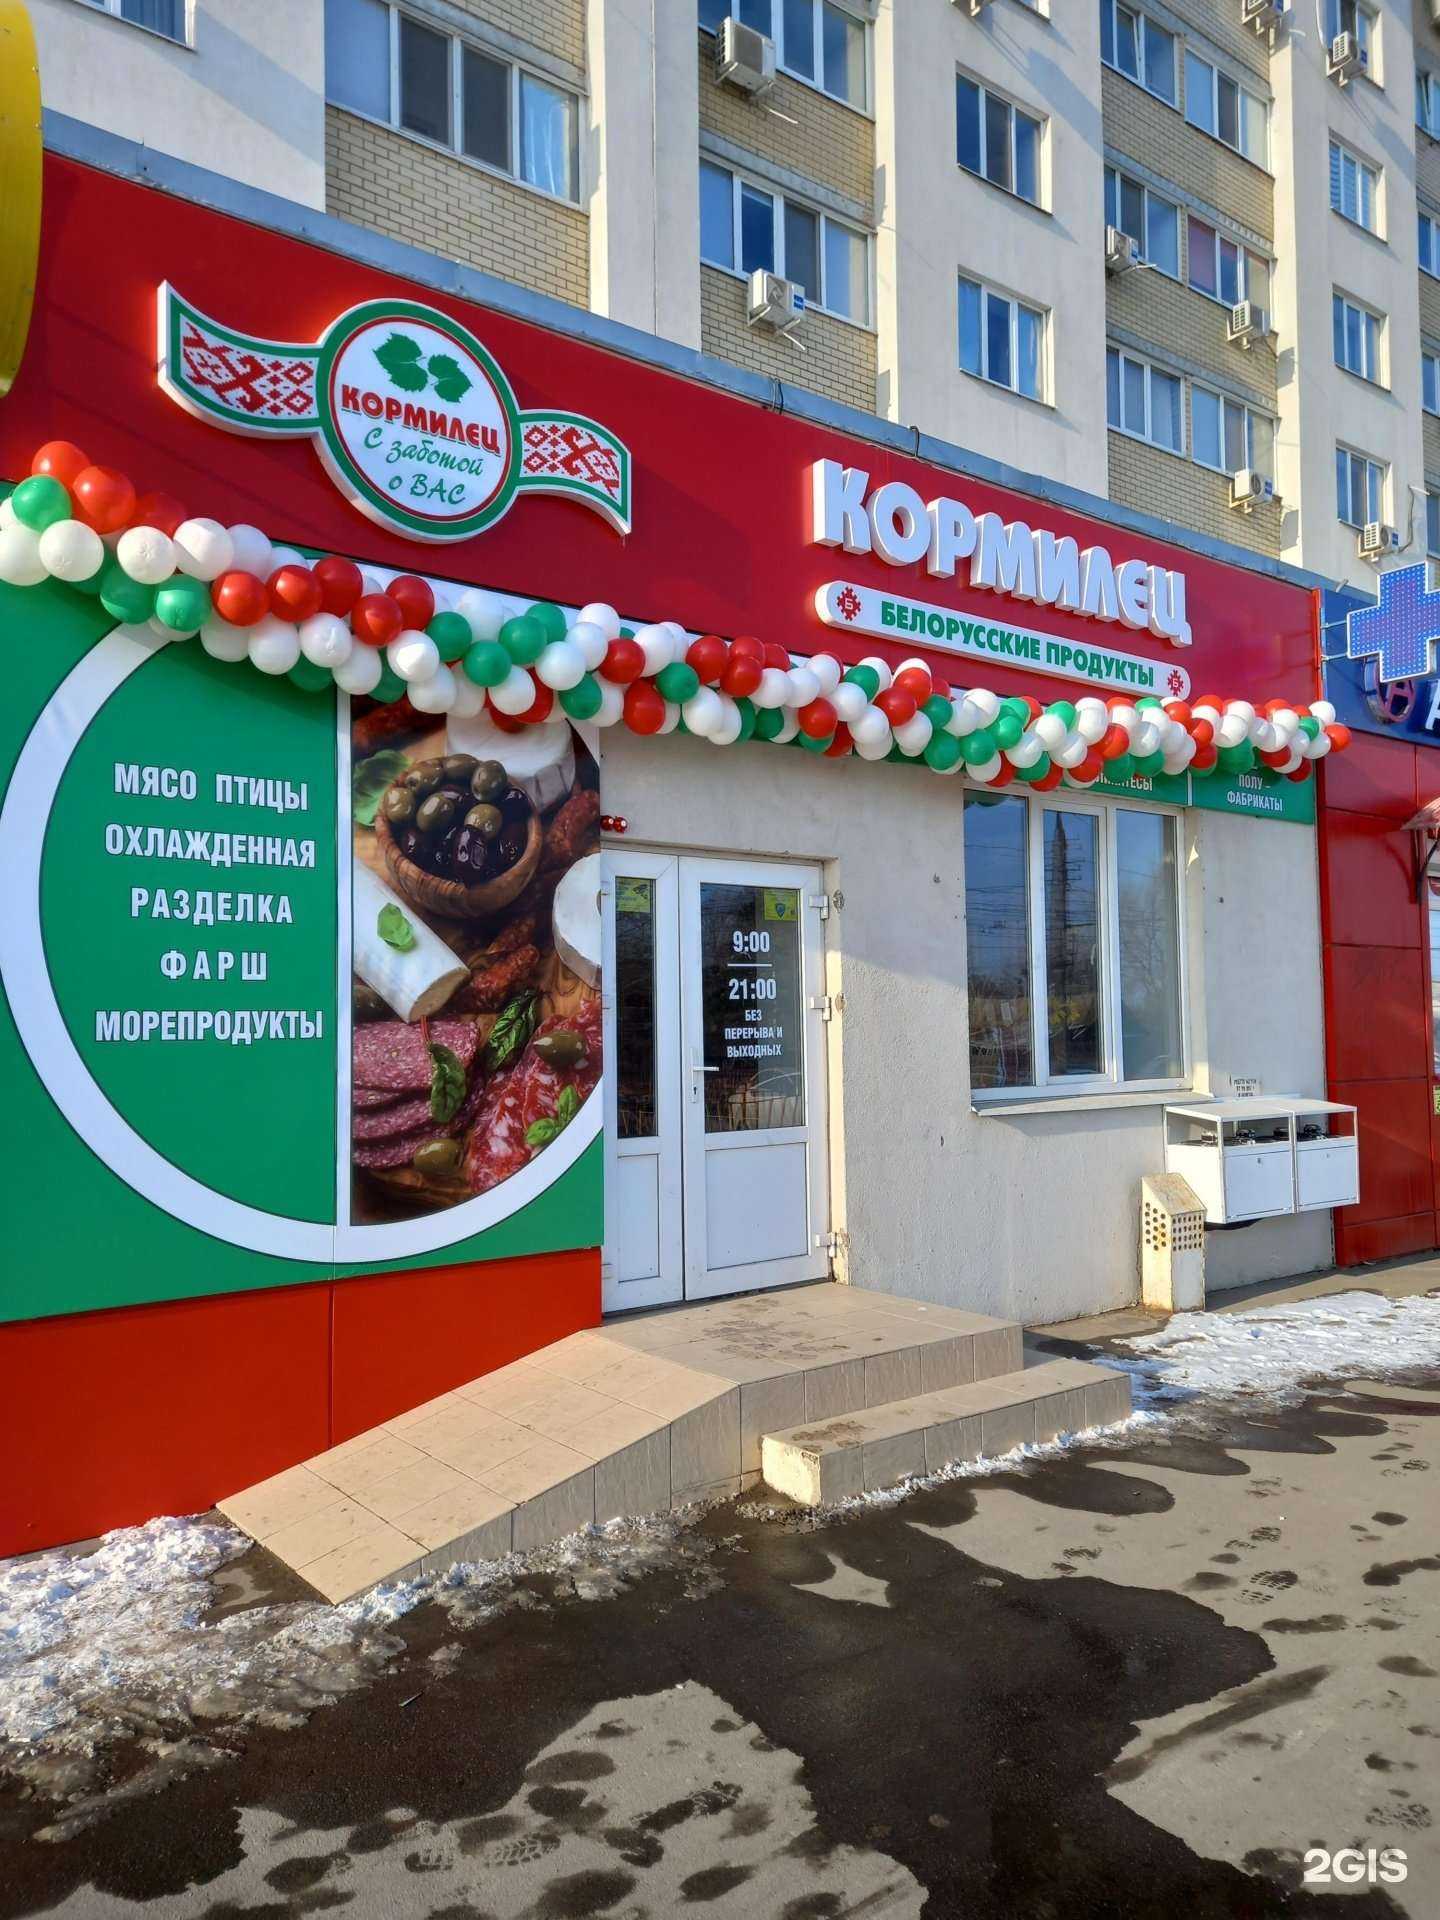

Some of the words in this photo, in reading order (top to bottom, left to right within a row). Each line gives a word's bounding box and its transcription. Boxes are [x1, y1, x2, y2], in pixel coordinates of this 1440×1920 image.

[341, 384, 501, 457] КОРМИЛЕЦ
[364, 427, 383, 449] С
[385, 440, 484, 476] заботой
[410, 473, 467, 505] ВАС
[812, 458, 1192, 649] КОРМИЛЕЦ
[881, 600, 1041, 661] БЕЛОРУССКИЕ
[1046, 641, 1154, 687] ПРОДУКТЫ
[114, 762, 197, 800] МЯСО
[215, 774, 308, 813] ПТИЦЫ
[1227, 791, 1283, 811] ФАБРИКАТЫ
[105, 824, 315, 868] ОХЛАЖДЕННАЯ
[131, 887, 293, 926] РАЗДЕЛКА
[733, 931, 770, 952] 9:00
[160, 950, 267, 980] ФАРШ
[728, 978, 777, 1000] 21:00
[95, 1010, 323, 1045] МОРЕПРОДУКТЫ
[745, 1009, 762, 1021] БЕЗ
[725, 1027, 775, 1040] ПЕРЕРЫВА
[776, 1027, 783, 1038] И
[727, 1044, 782, 1058] ВЫХОДНЫХ
